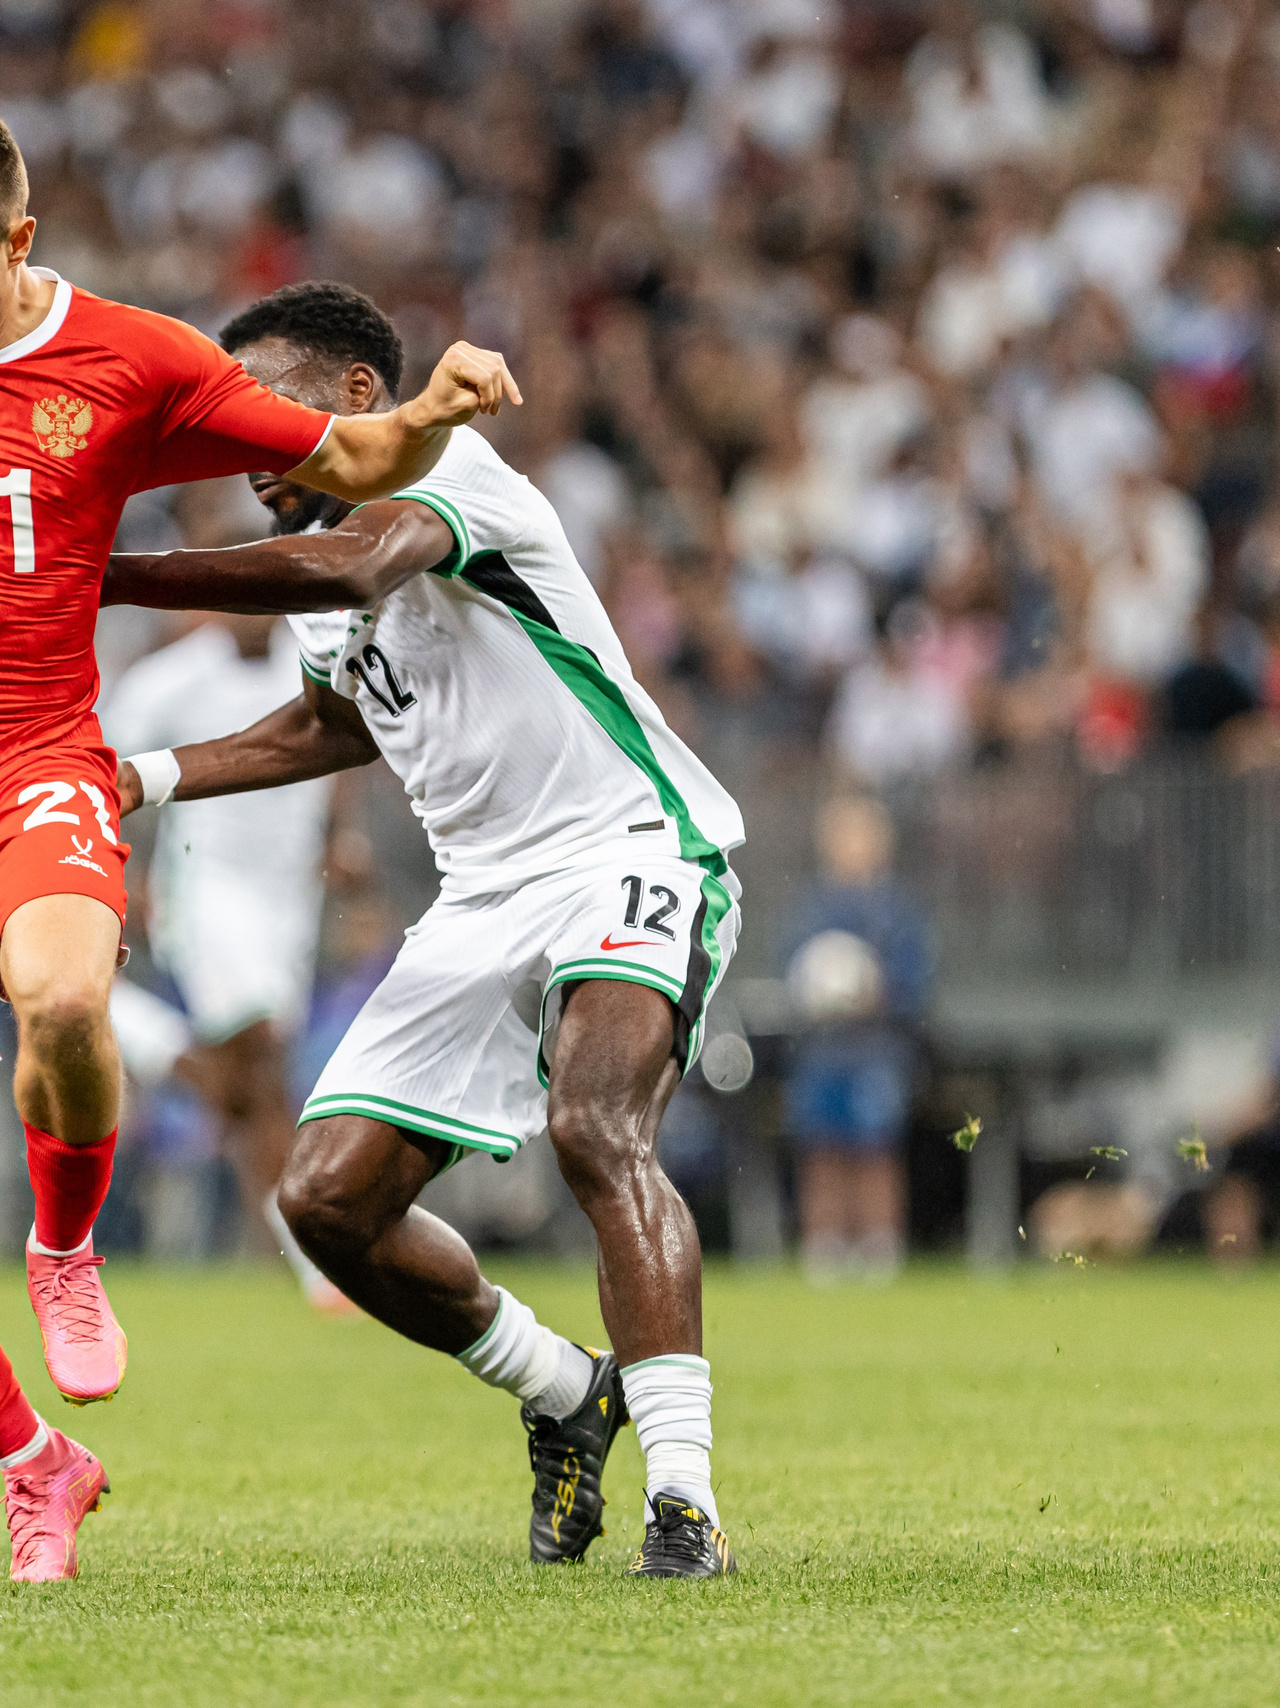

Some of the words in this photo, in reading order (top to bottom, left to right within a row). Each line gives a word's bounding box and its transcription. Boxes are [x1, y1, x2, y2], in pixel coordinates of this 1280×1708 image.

[345, 643, 418, 718] 12
[17, 780, 118, 846] 21
[621, 874, 682, 942] 12
